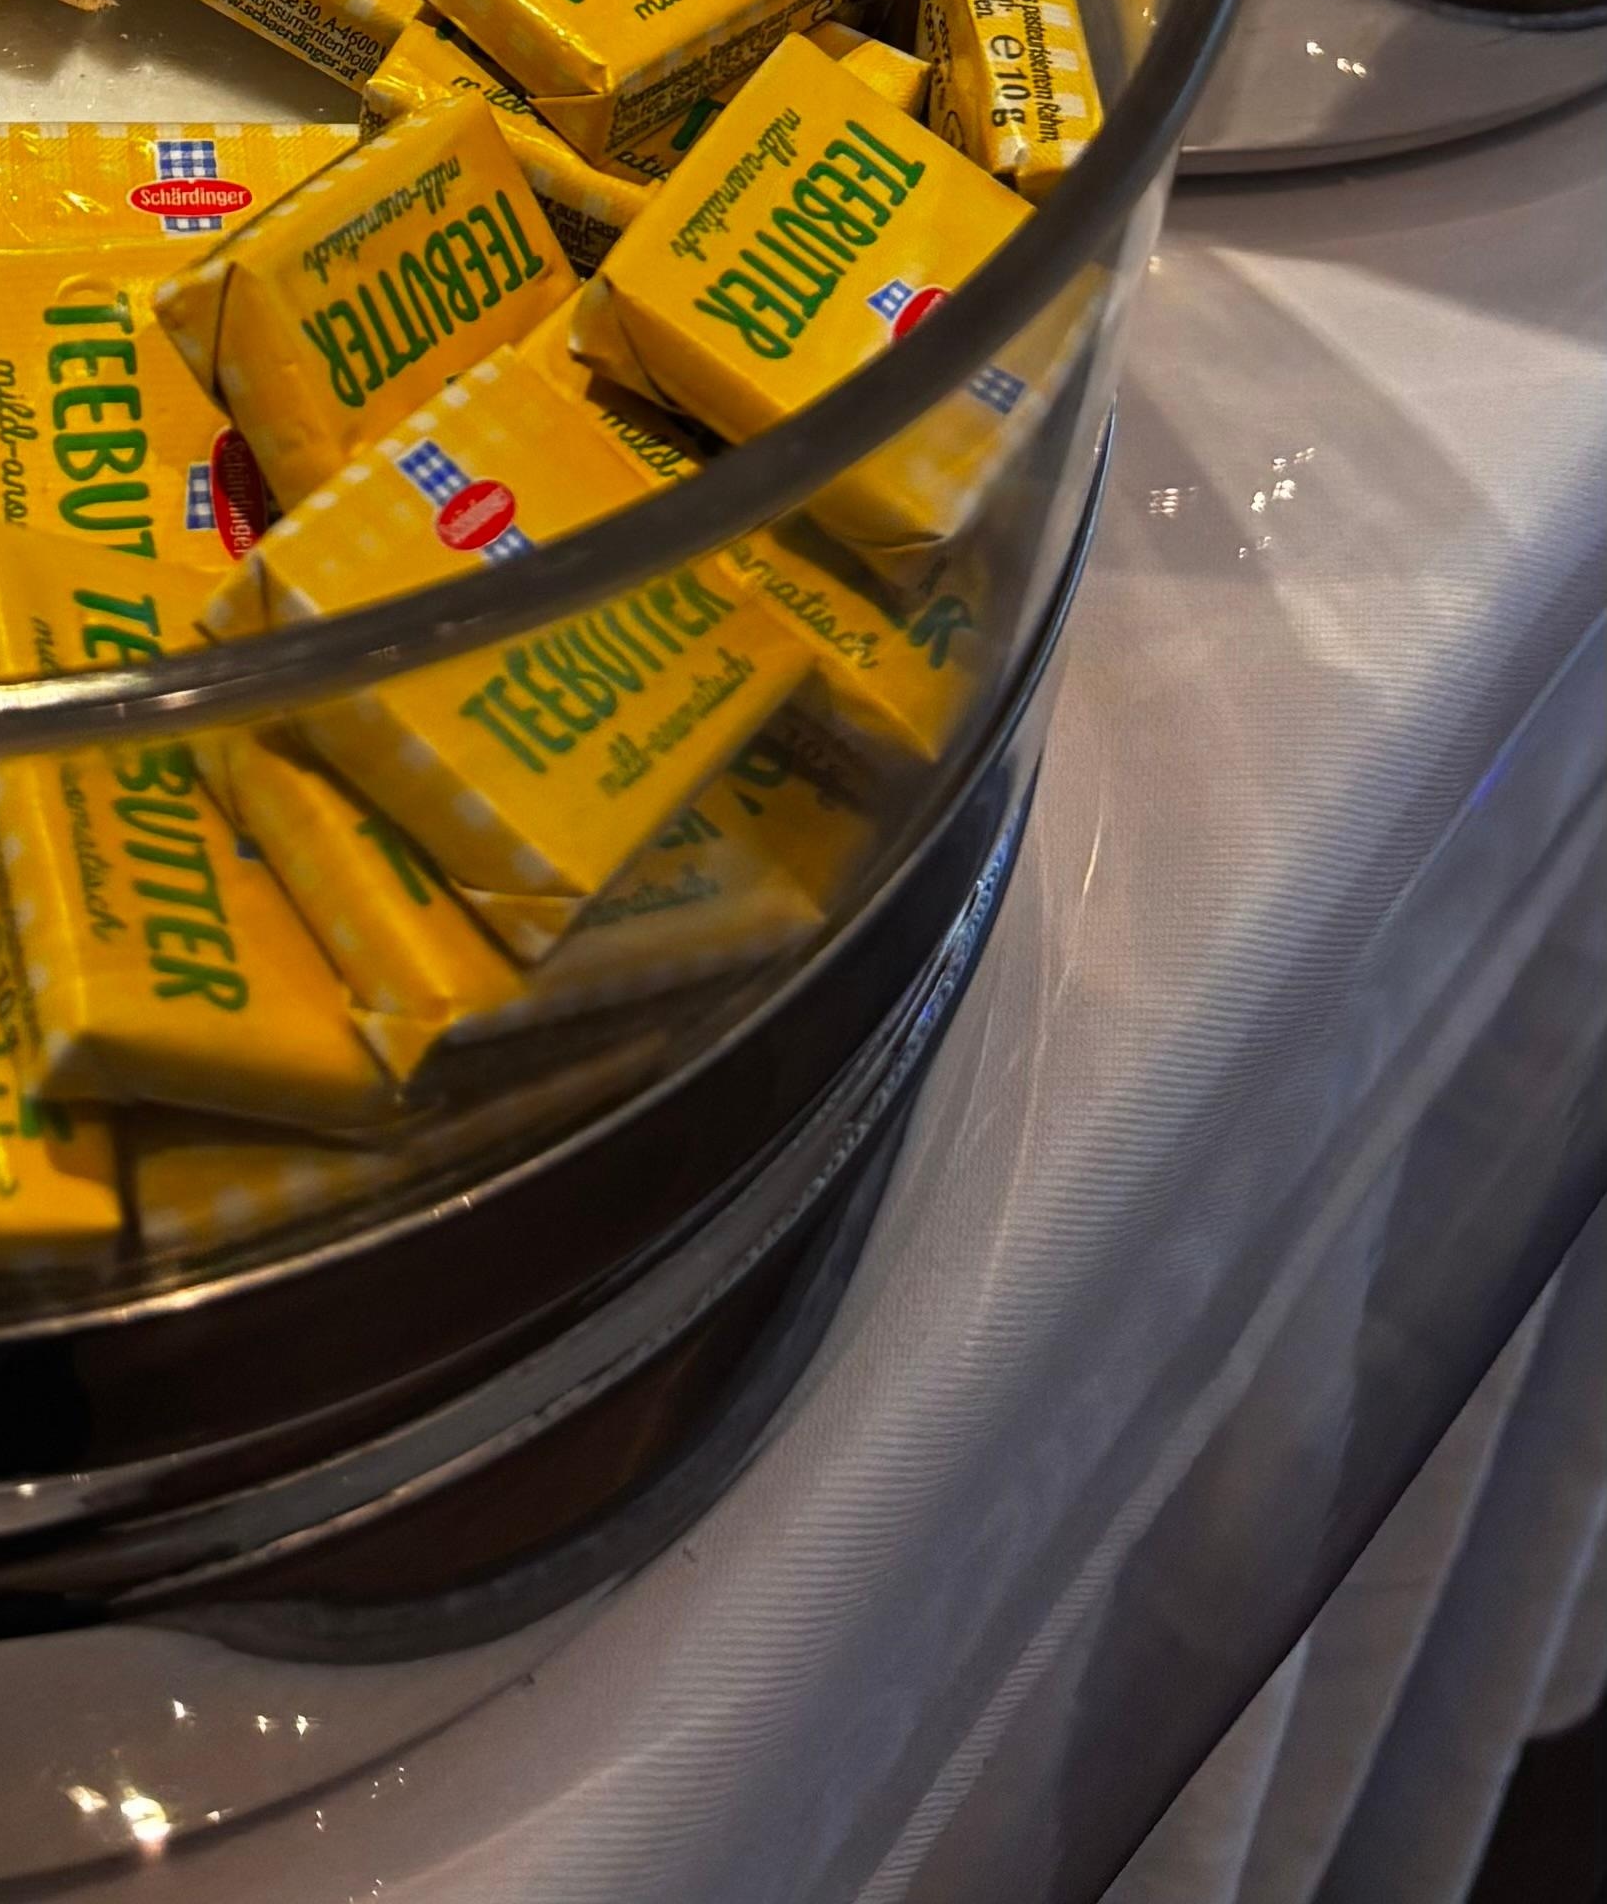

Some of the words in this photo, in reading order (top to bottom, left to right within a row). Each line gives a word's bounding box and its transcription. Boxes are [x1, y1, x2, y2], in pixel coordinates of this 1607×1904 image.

[322, 14, 380, 58] A-4600
[995, 66, 1030, 104] 10
[990, 104, 1027, 129] g
[139, 188, 248, 208] Schärdinger
[694, 120, 926, 360] TEEBUTTER
[301, 190, 544, 409] TEEBUTTER
